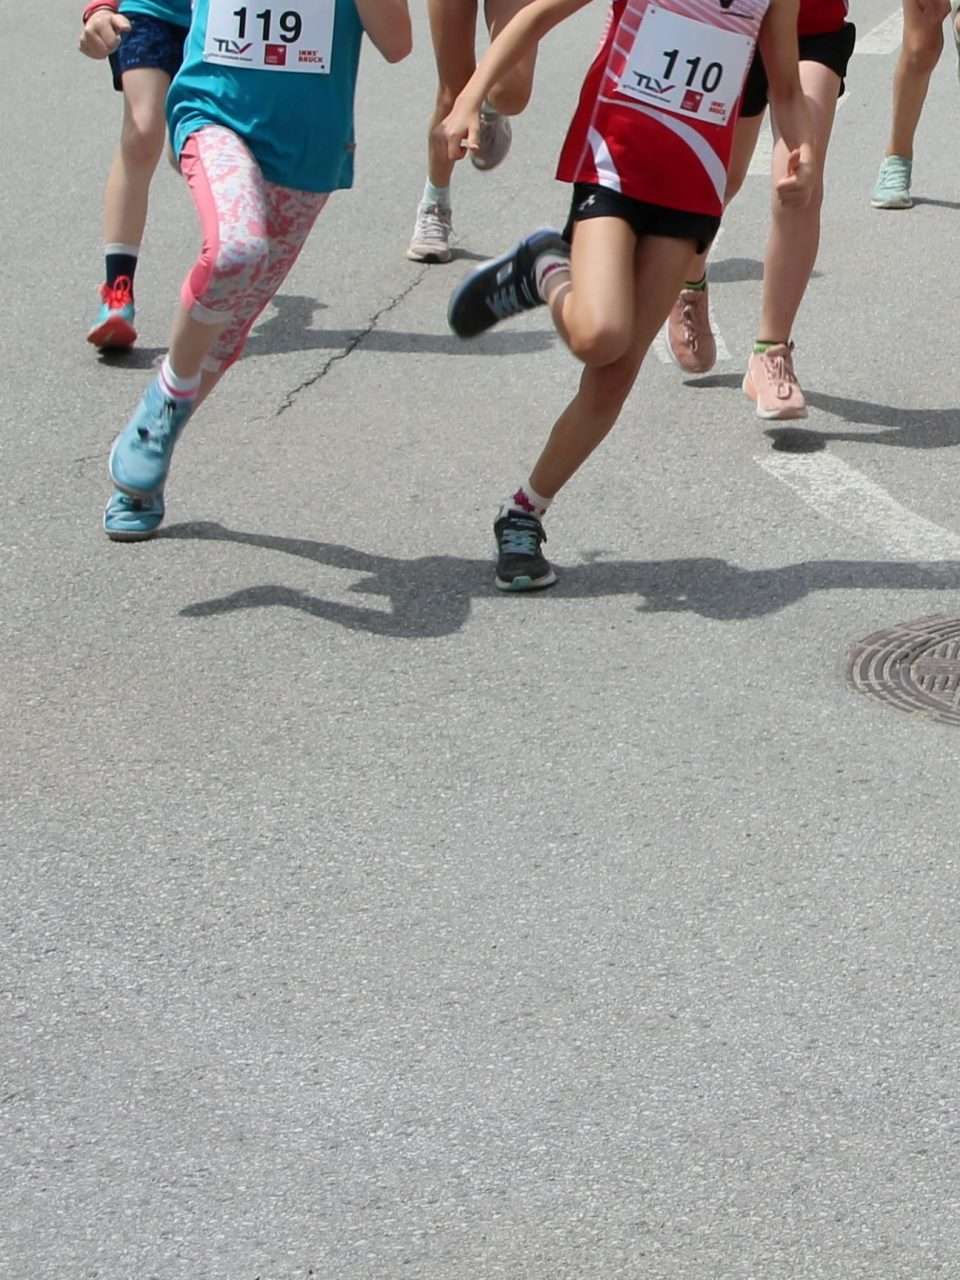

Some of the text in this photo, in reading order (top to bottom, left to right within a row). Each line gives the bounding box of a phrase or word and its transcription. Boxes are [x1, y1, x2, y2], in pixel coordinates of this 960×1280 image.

[234, 7, 302, 43] 119
[213, 38, 253, 54] TLV
[663, 49, 723, 93] 110
